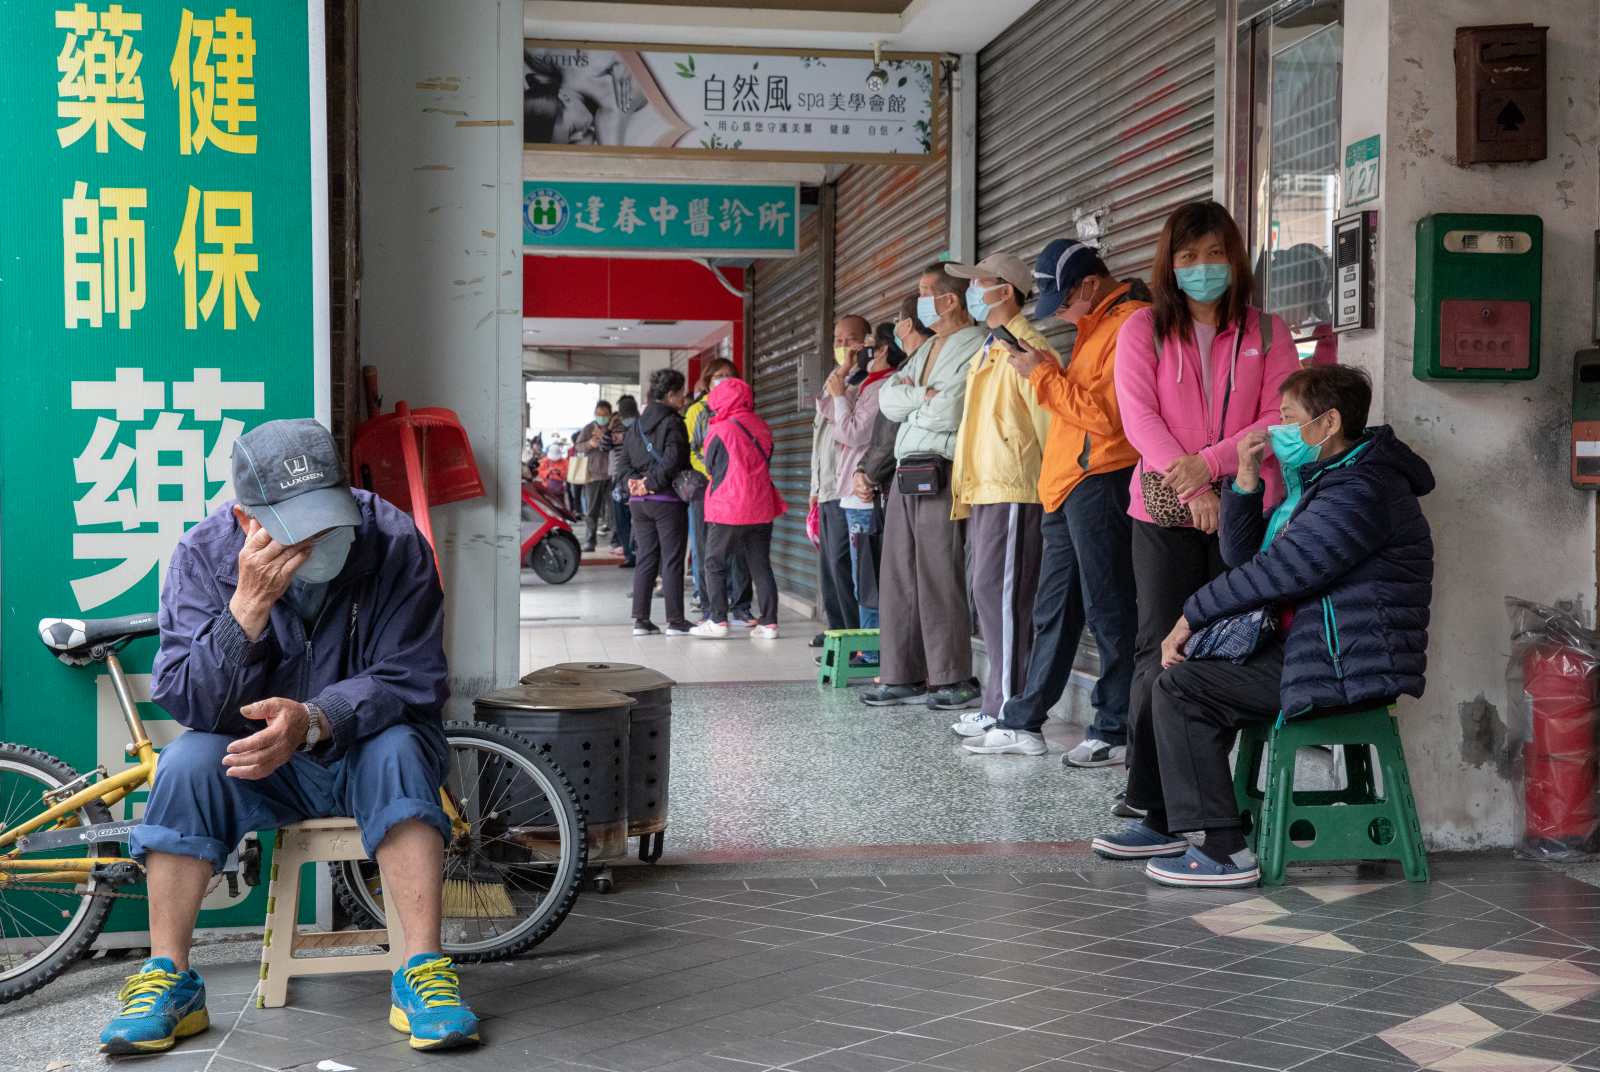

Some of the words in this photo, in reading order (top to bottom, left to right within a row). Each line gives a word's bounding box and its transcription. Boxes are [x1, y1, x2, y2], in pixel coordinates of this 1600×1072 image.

[535, 54, 590, 67] SOTHYS
[704, 74, 791, 112] 自然風
[798, 93, 825, 111] spa
[829, 92, 906, 113] 美學會館
[55, 3, 147, 330] 藥師
[170, 8, 261, 331] 健保
[1461, 235, 1514, 250] 信箱
[280, 471, 324, 489] LUXGEN
[98, 827, 132, 837] GIAN
